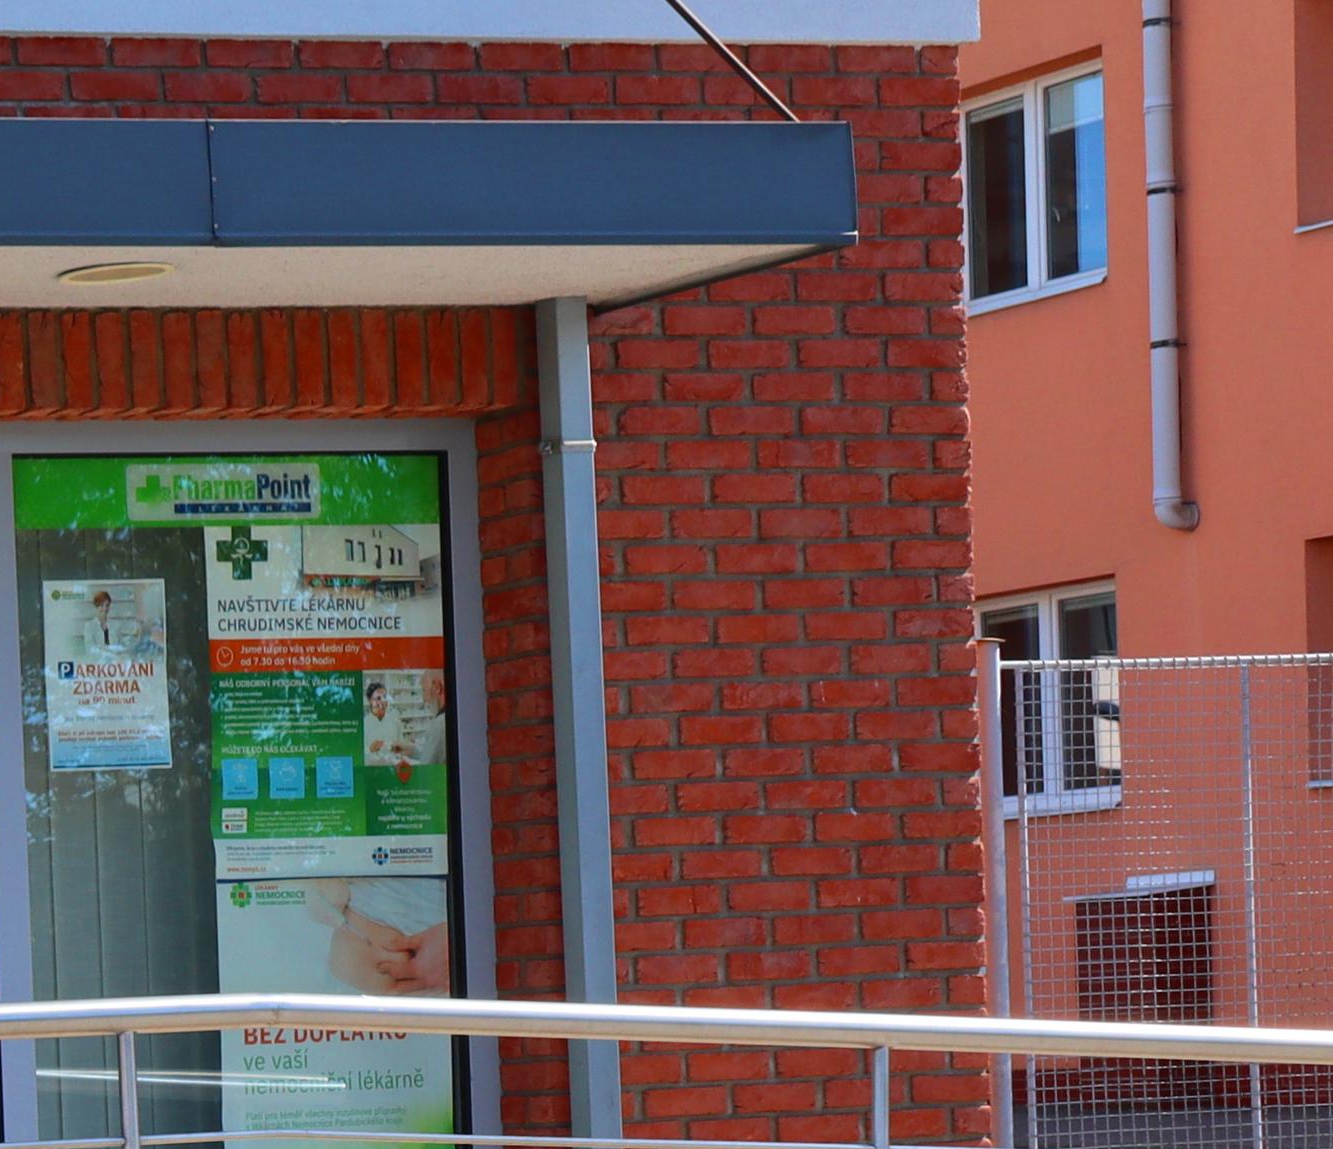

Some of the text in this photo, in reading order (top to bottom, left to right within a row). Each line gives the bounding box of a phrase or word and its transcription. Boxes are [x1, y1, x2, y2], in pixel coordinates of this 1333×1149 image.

[172, 473, 311, 500] PharmaPoint
[217, 595, 366, 613] NAVŠTIVTE LÉKÁRNU
[218, 614, 401, 632] CHRUDIMSKÉ NEMOCNICE
[240, 645, 262, 654] Jsme
[290, 643, 304, 653] vás
[59, 660, 154, 679] PARKOVÁNÍ
[240, 657, 252, 666] od
[254, 657, 272, 666] 7.30
[274, 656, 284, 665] do
[312, 655, 336, 665] hodin
[73, 679, 141, 696] ZDARMA
[389, 847, 432, 855] NEMOCNICE
[255, 890, 306, 899] NEMOCNICE
[243, 1028, 287, 1046] BEZ
[243, 1049, 309, 1071] ve vaší
[244, 1067, 425, 1096] nemocniční lékárně
